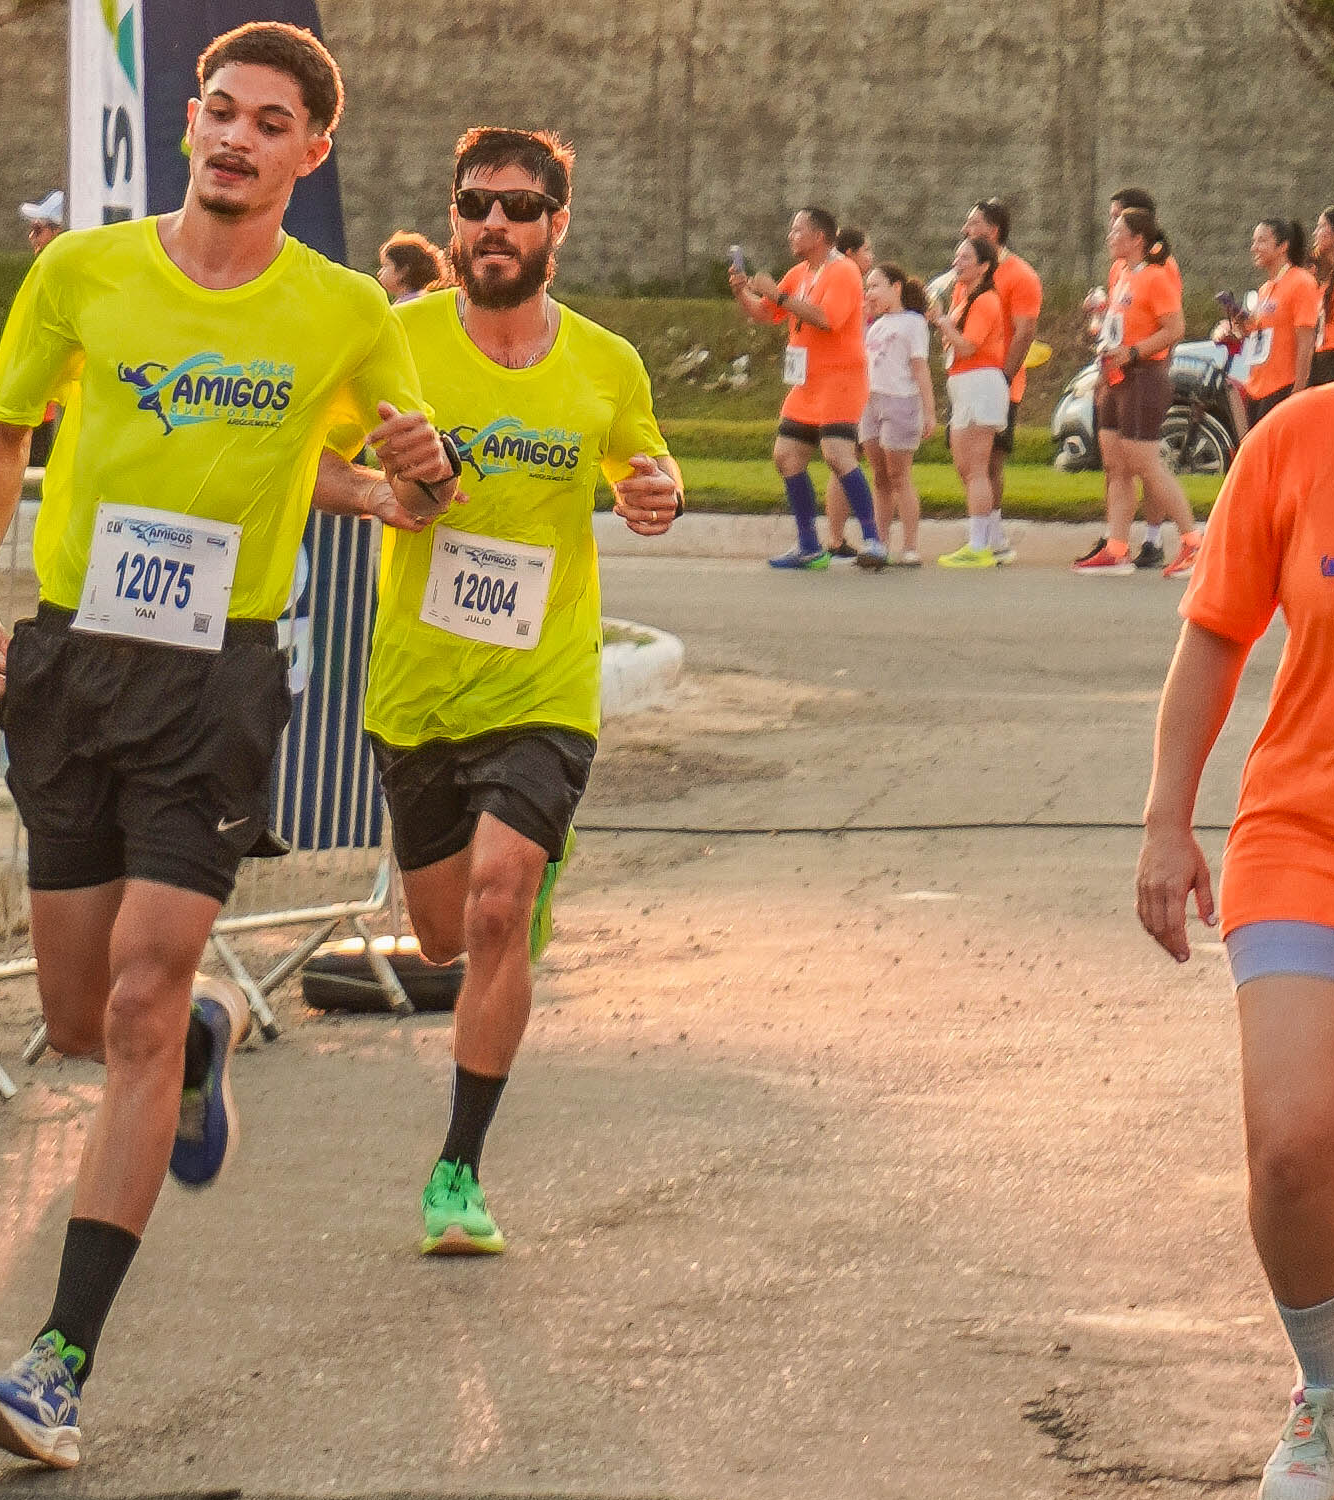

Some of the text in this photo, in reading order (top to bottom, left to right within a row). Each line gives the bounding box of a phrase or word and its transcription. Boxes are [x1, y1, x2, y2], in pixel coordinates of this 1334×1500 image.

[172, 374, 293, 410] AMIGOS
[482, 434, 580, 469] AMIGOS
[148, 526, 193, 545] AMIGOS
[481, 551, 517, 567] AMIGOS
[115, 551, 195, 609] 12075
[453, 570, 519, 618] 12004
[134, 606, 157, 620] YAN
[464, 614, 492, 627] JULIO
